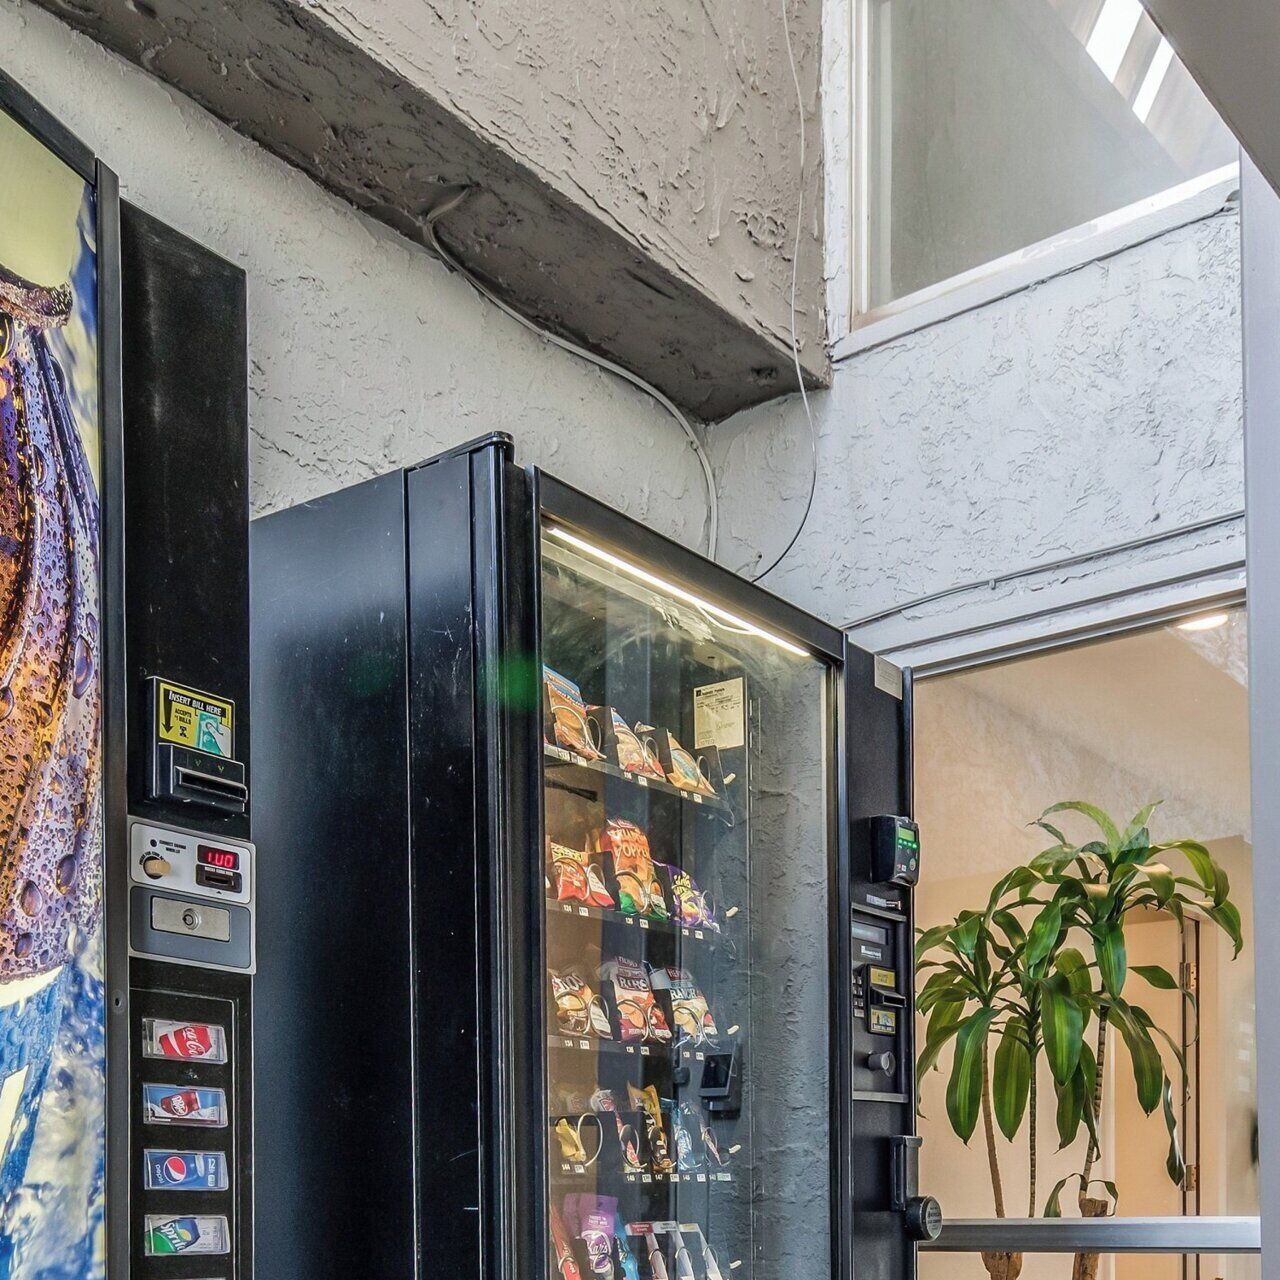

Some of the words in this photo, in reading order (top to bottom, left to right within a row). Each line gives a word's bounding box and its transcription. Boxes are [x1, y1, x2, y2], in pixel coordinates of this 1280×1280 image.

[169, 690, 191, 706] INSERT
[192, 699, 205, 711] BILL
[206, 704, 222, 716] HERE
